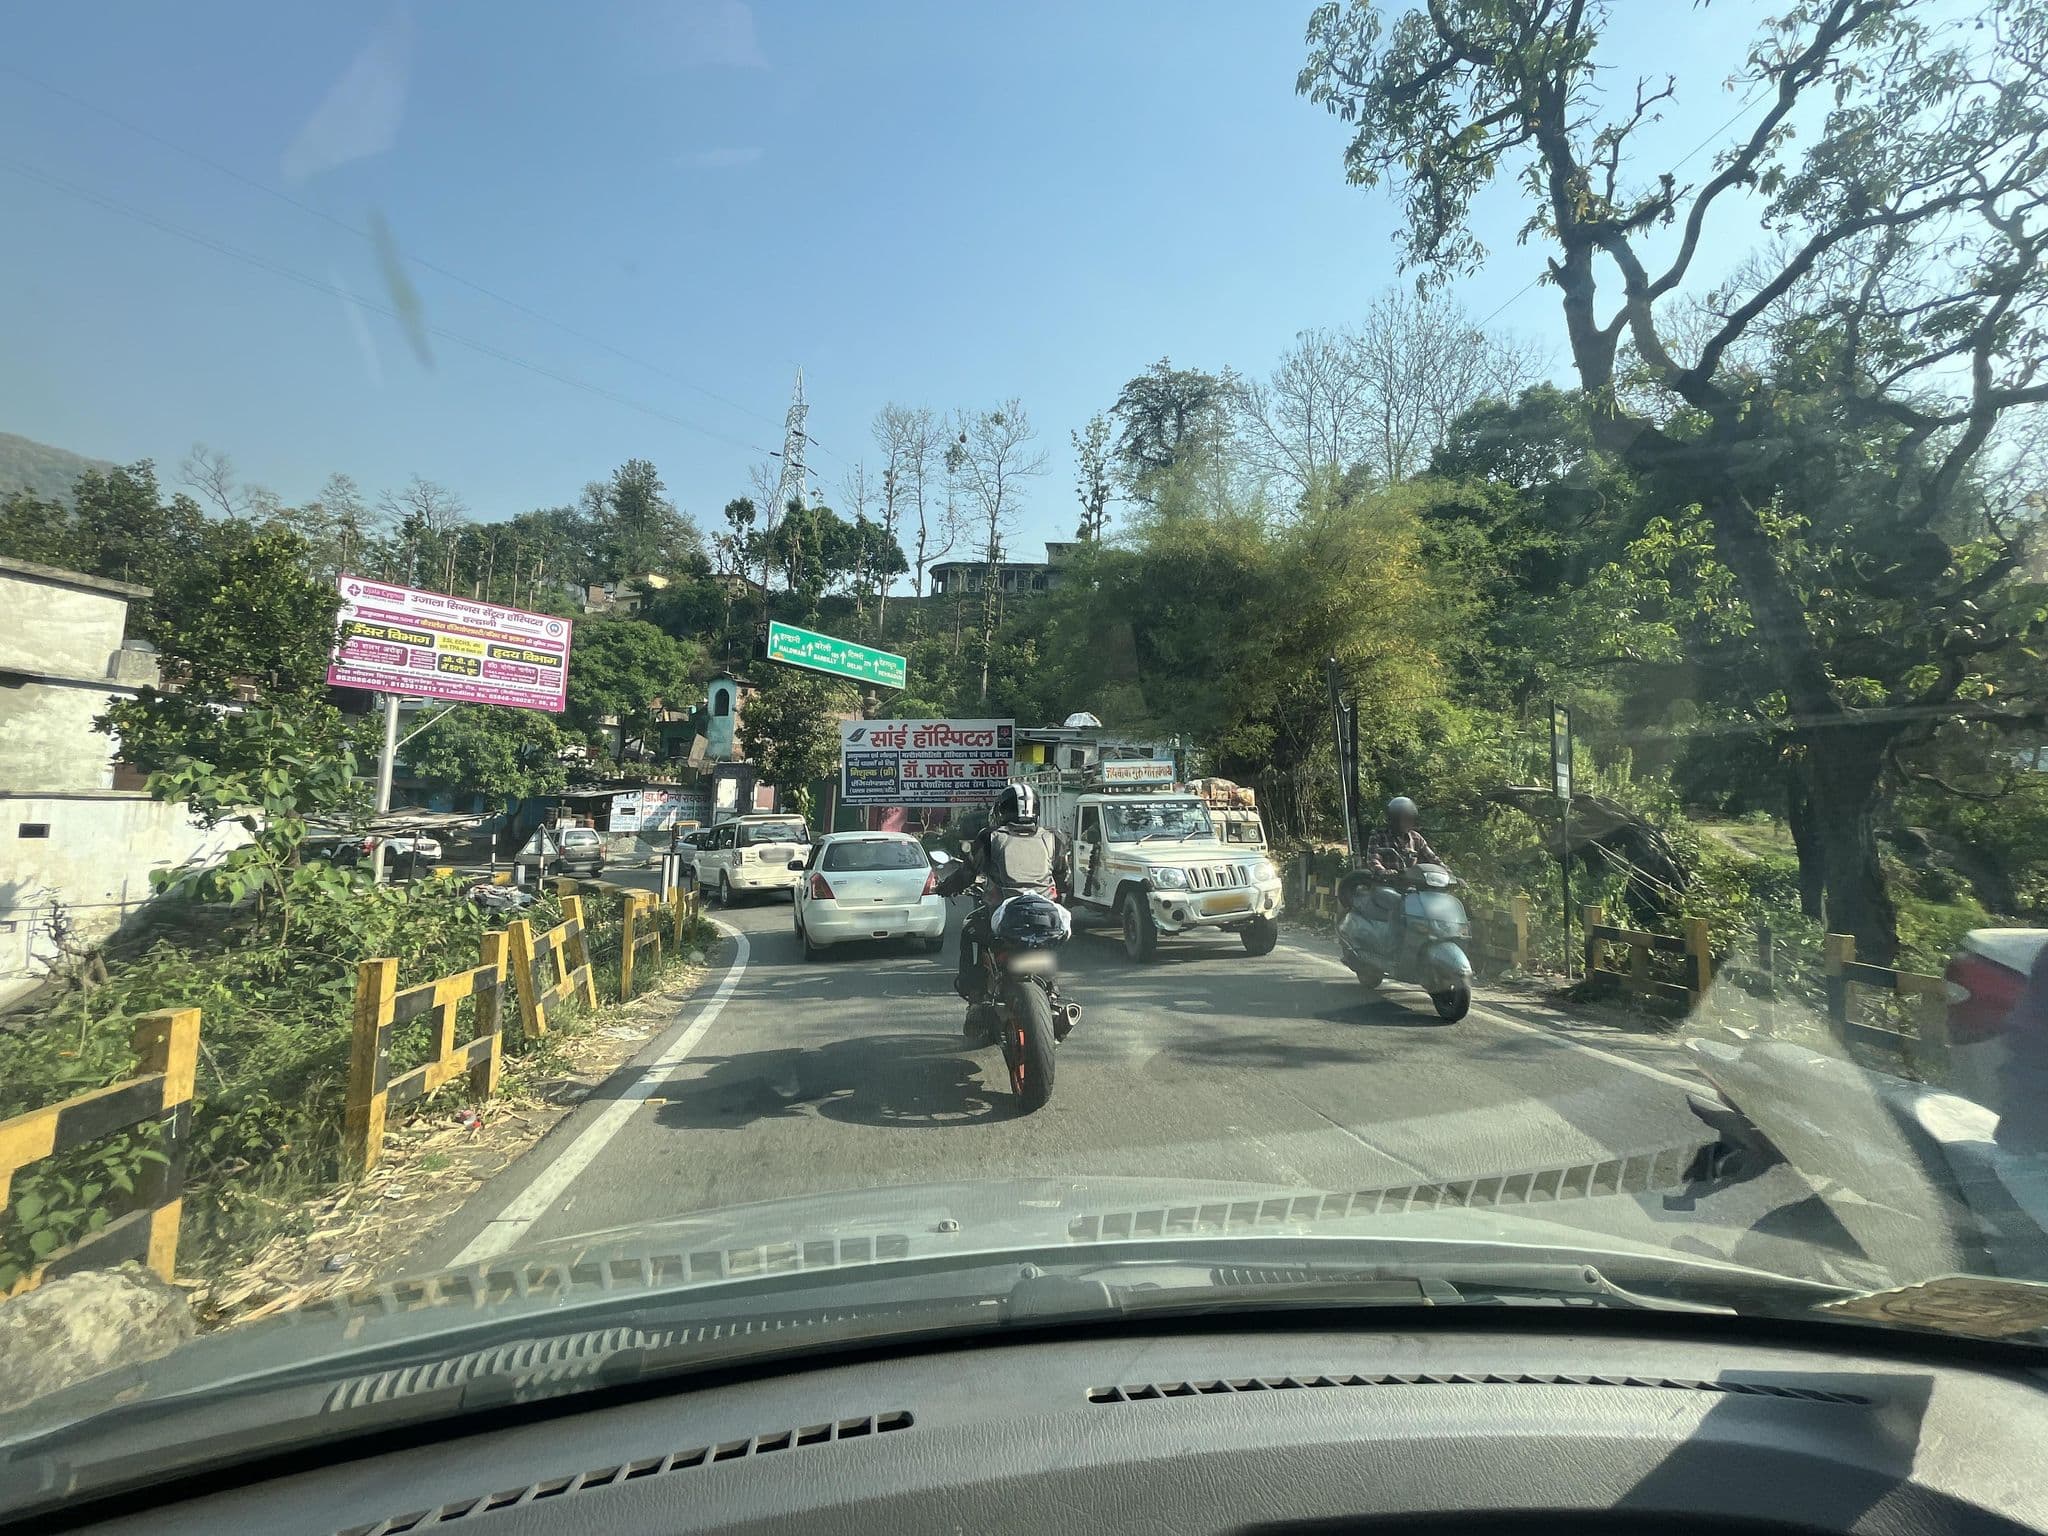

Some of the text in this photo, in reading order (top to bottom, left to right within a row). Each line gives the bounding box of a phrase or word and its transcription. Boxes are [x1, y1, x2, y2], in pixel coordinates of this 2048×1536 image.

[411, 594, 444, 608] उजाला
[447, 599, 480, 614] सिग्नस
[507, 613, 544, 627] हॉस्पिटल
[387, 628, 431, 646] विभाग
[492, 647, 521, 661] हृदय
[522, 650, 558, 665] विभाग
[870, 724, 996, 749] सांई हॉस्पिटल
[902, 760, 1009, 779] डॉ. प्रमोद जोशी
